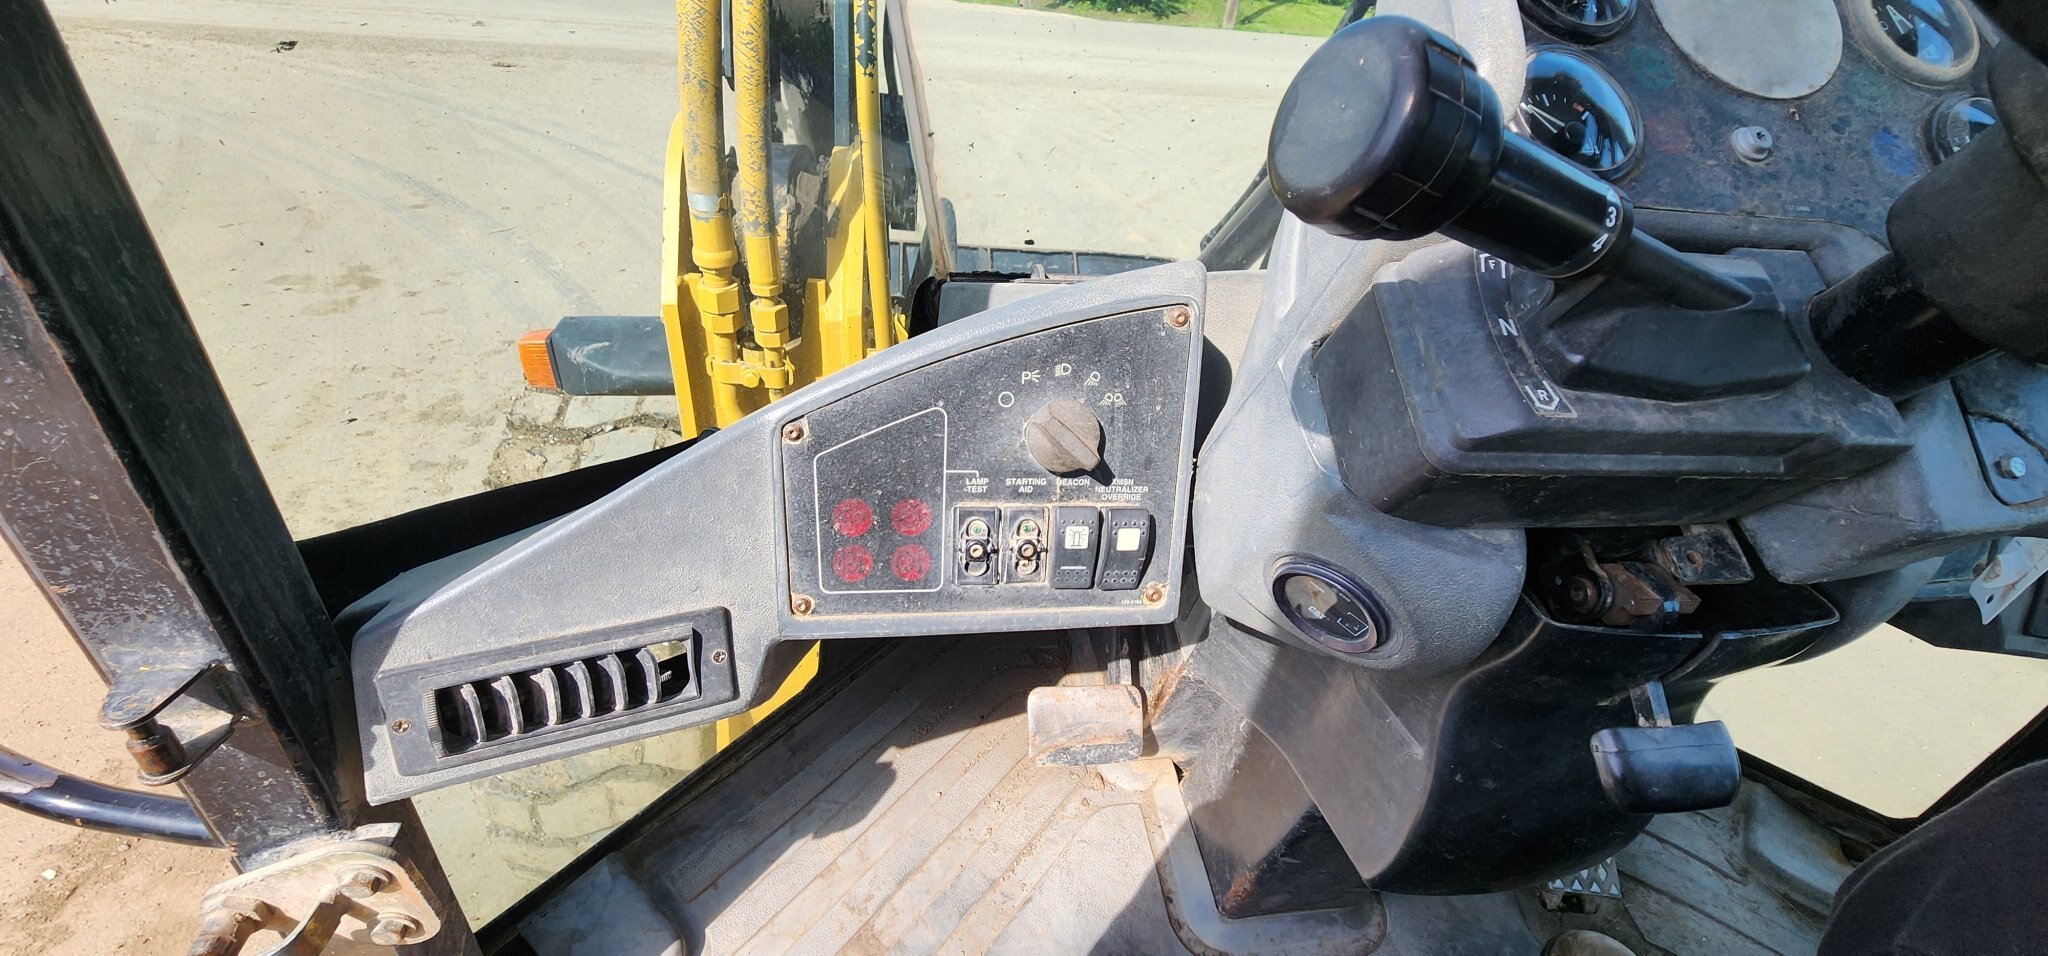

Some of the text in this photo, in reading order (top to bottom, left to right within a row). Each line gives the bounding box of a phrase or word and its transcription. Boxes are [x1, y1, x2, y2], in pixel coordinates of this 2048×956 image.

[1605, 206, 1617, 228] 3
[1592, 233, 1609, 253] 4
[1498, 318, 1519, 336] N
[1537, 389, 1549, 401] R
[965, 477, 990, 485] LAMP
[1005, 477, 1047, 486] STARTING
[1056, 478, 1091, 486] BEACON
[1111, 478, 1134, 486] XMSN
[966, 485, 989, 493] TEST
[1018, 485, 1034, 493] AID
[1094, 485, 1149, 493] NEUTRALIZER
[1101, 493, 1142, 501] OVERRIDE
